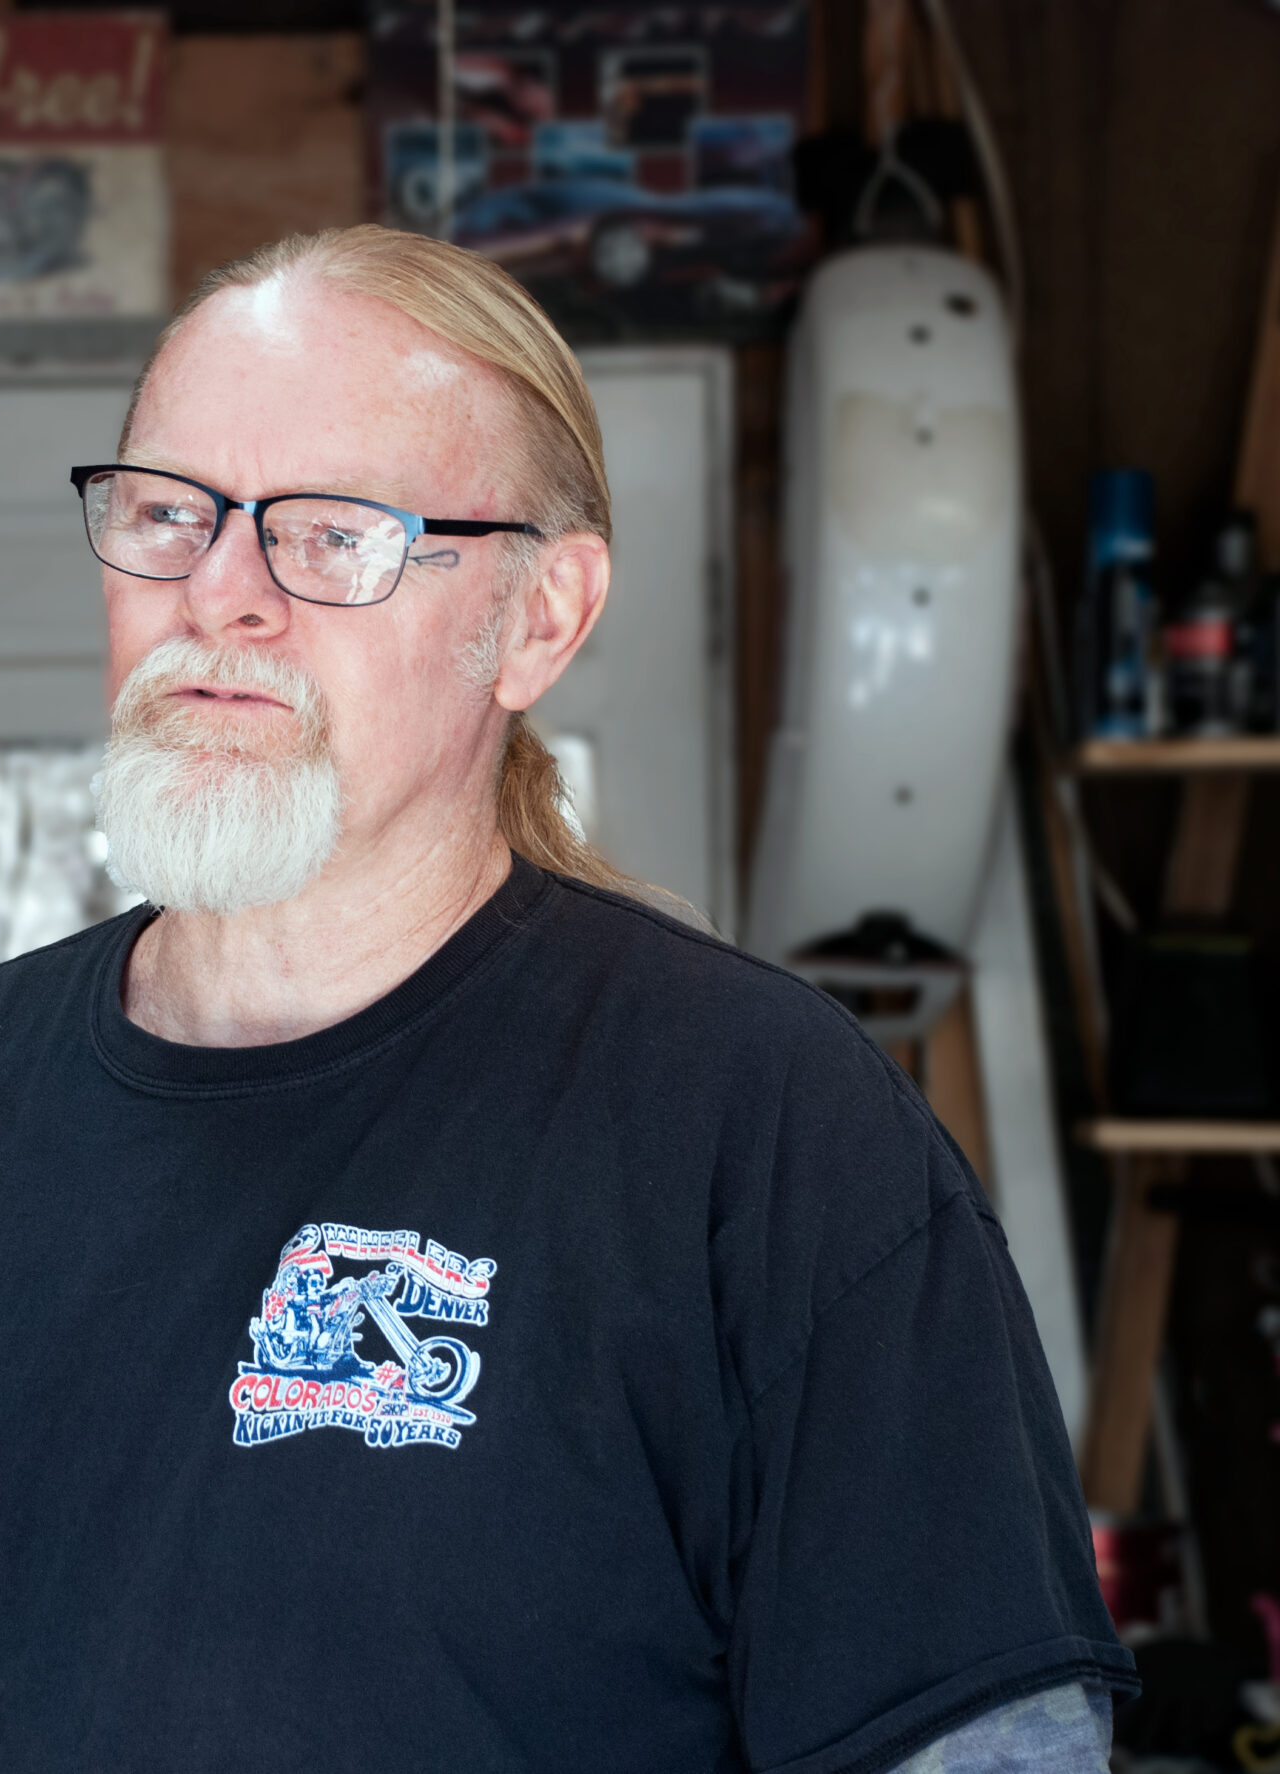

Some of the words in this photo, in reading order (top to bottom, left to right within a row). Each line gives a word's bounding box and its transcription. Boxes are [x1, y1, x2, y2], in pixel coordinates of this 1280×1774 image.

[322, 1223, 496, 1297] WHEELERS
[387, 1263, 404, 1275] OF
[395, 1272, 488, 1324] DENVER
[231, 1374, 377, 1412] COLORADO'S
[380, 1403, 409, 1416] SHOP
[310, 1411, 329, 1427] IT
[329, 1410, 368, 1432] FOR
[368, 1418, 393, 1446] 50
[394, 1420, 460, 1447] YEARS
